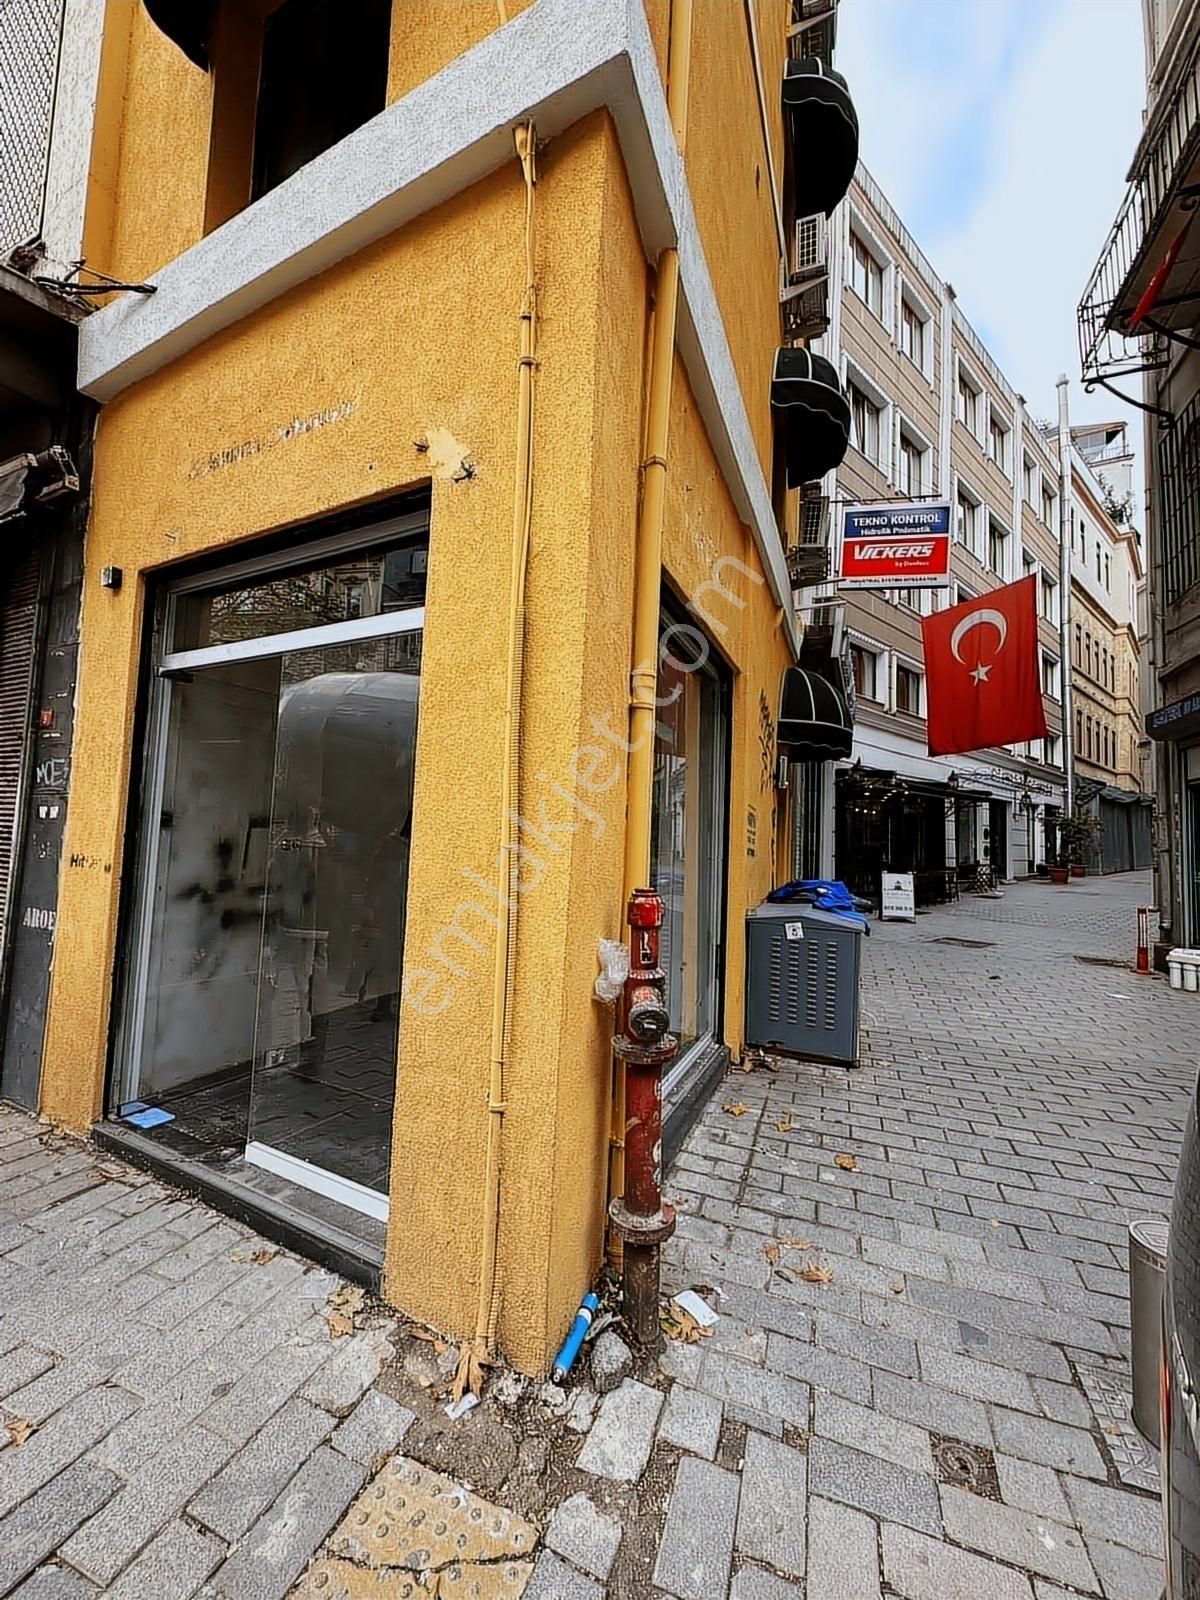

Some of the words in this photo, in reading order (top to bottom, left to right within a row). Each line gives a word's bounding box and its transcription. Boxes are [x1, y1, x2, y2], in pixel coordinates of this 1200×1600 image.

[853, 517, 888, 526] TEKNO
[890, 513, 941, 525] KONTROL
[854, 541, 936, 560] VICKERS
